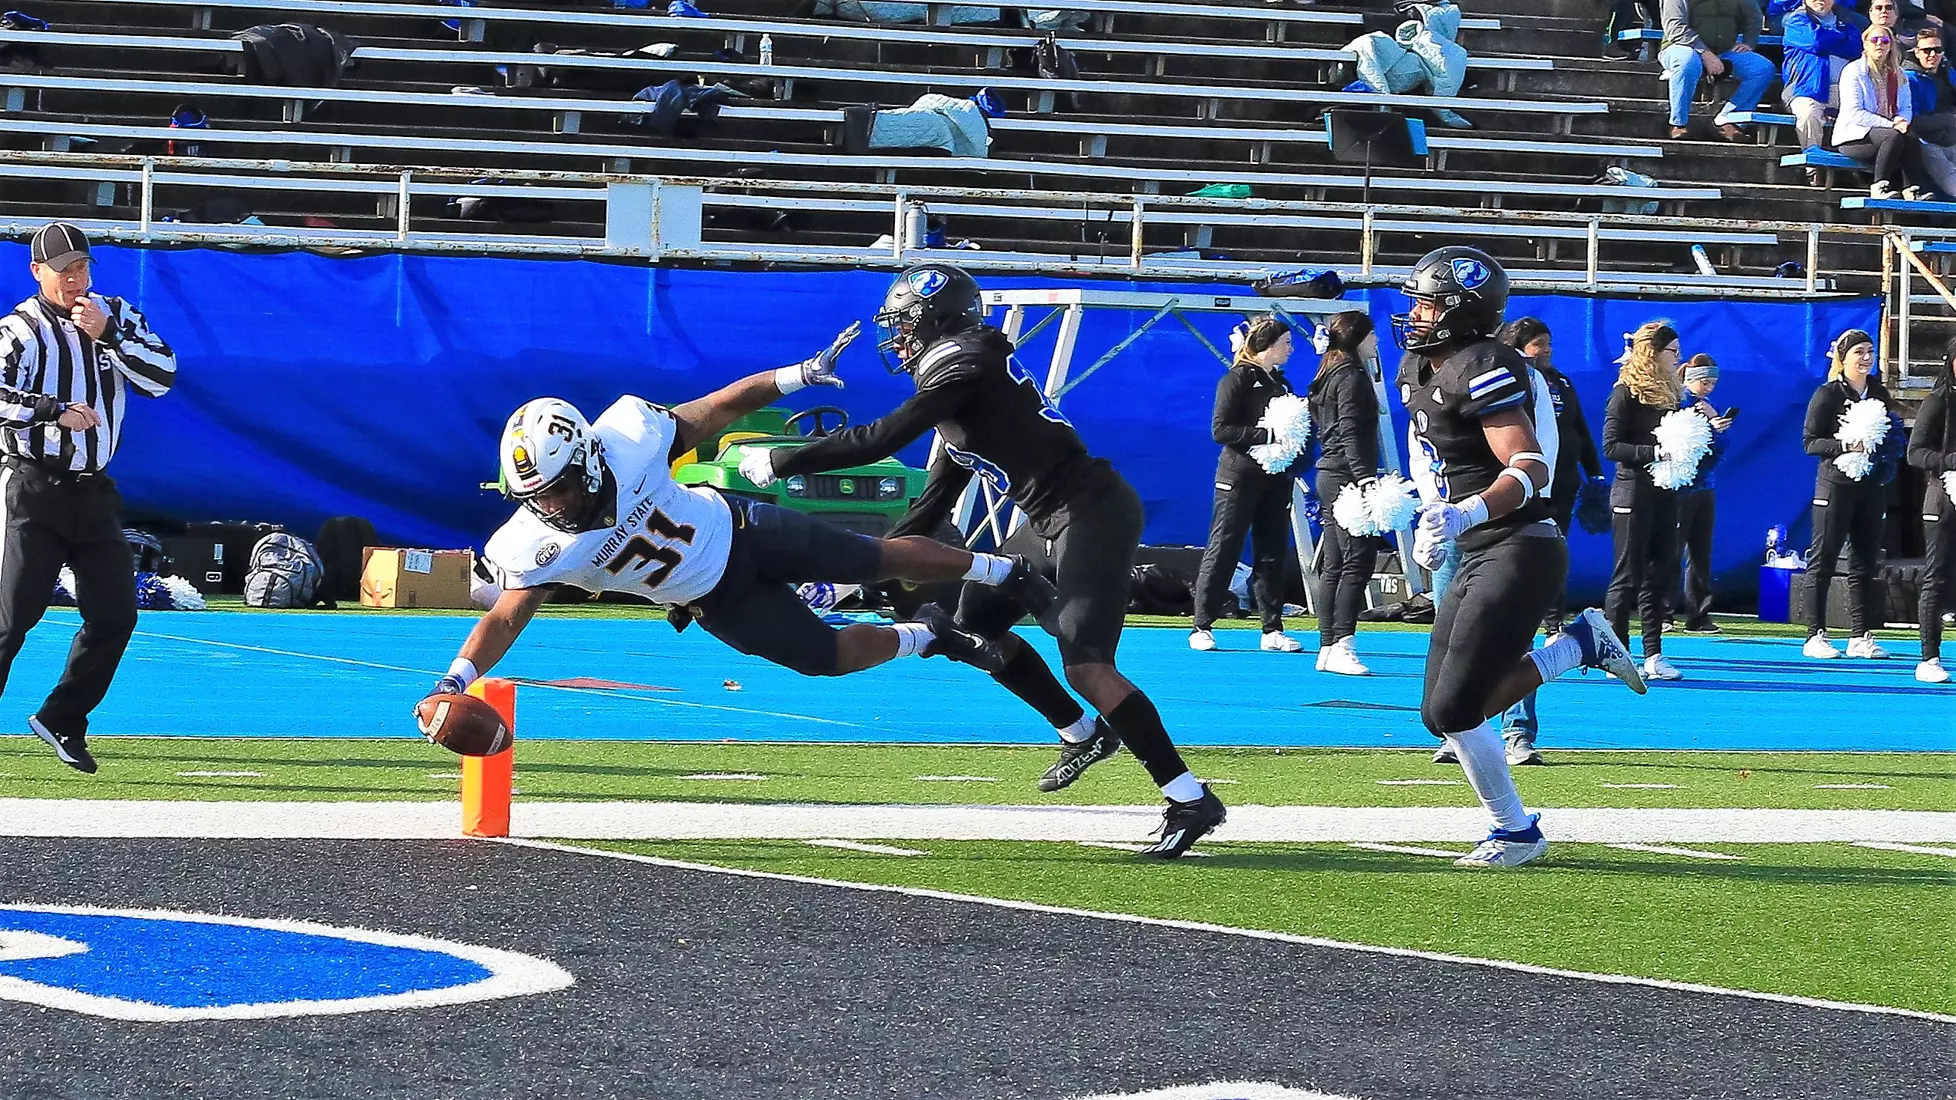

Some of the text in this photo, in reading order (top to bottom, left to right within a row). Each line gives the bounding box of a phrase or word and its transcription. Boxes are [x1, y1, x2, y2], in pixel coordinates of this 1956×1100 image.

[548, 414, 576, 443] 31
[591, 496, 655, 568] MURRAY STATE
[604, 506, 697, 589] 31
[1600, 631, 1624, 658] adidas
